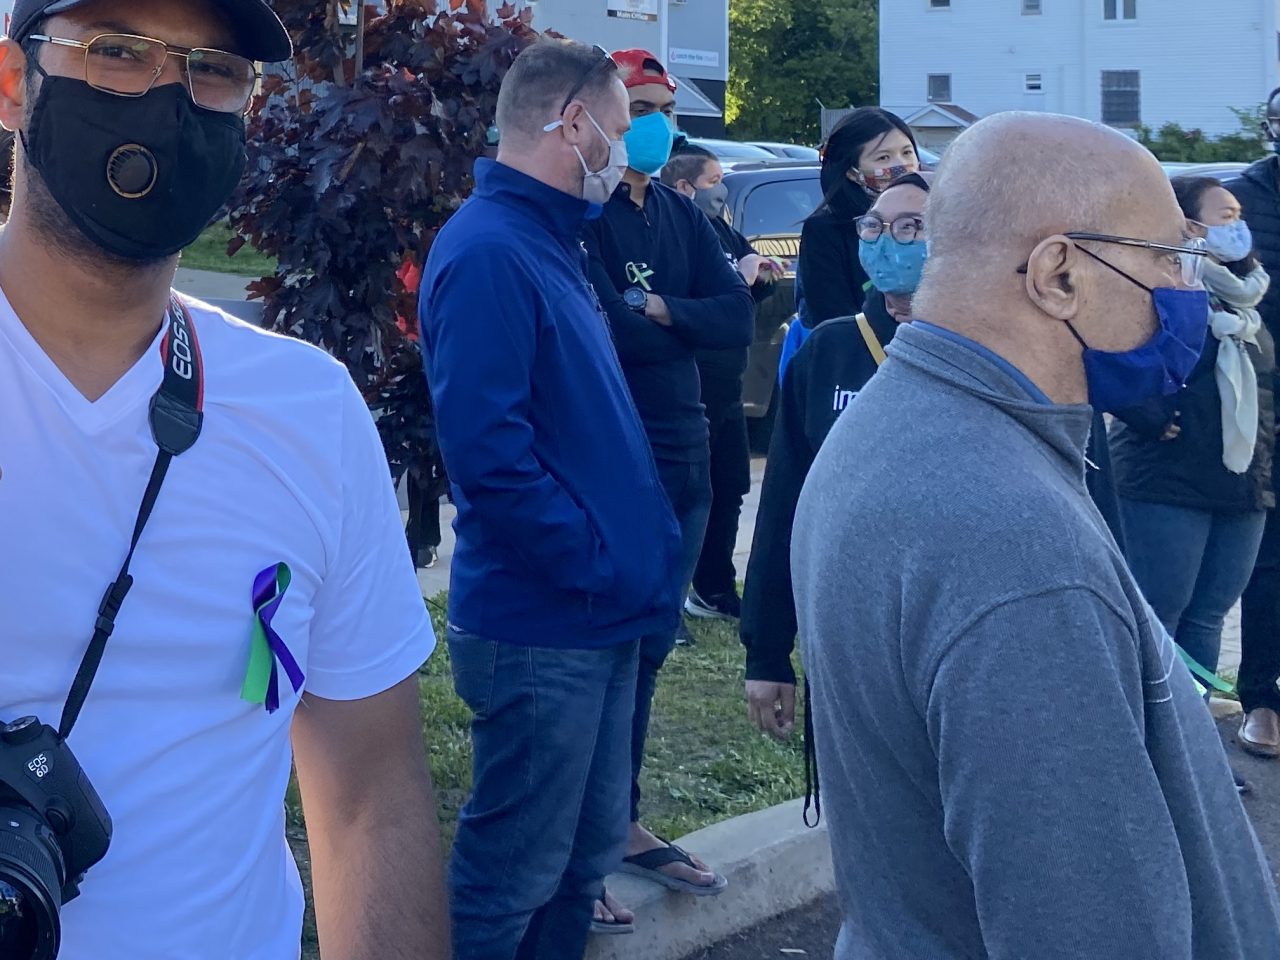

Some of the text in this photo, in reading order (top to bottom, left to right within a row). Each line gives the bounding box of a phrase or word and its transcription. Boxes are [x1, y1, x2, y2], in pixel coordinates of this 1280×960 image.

[172, 321, 192, 380] EOS
[27, 753, 47, 772] EOS
[36, 764, 49, 778] 6D
